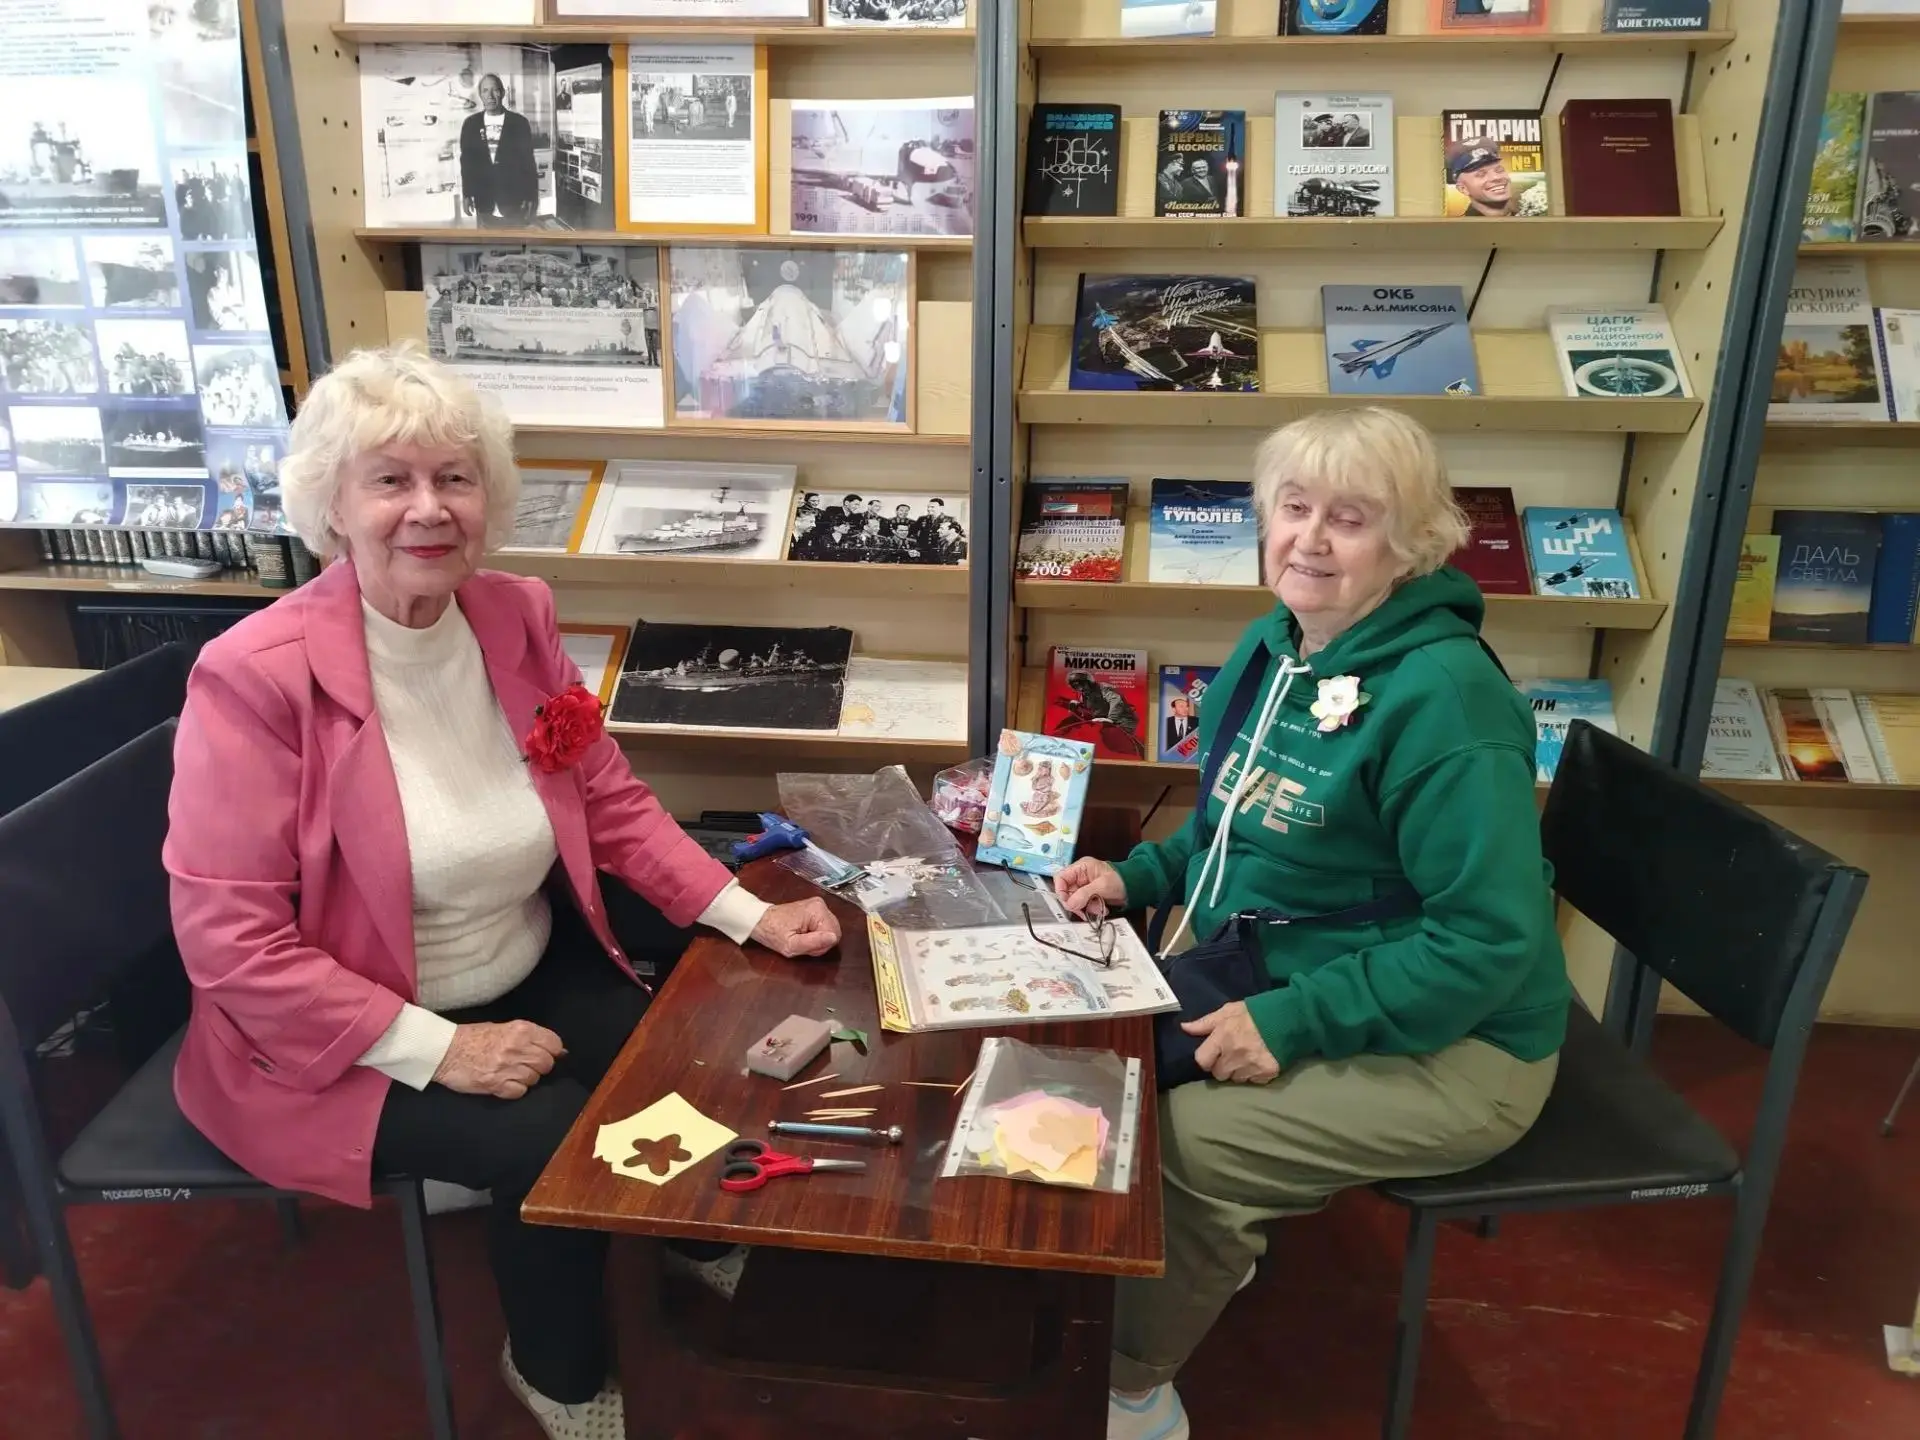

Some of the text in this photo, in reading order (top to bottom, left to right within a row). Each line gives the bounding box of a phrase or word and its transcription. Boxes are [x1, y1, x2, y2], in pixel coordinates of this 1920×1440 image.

[1617, 16, 1703, 29] КОНСТРУКТОРЫ
[1450, 119, 1541, 142] ГАГАРИН
[1169, 132, 1225, 143] ПЕРВЫЕ
[1168, 143, 1225, 152] В КОСМОСЕ
[1287, 164, 1389, 175] СДЕЛАНО В РОССИИ
[794, 212, 818, 223] 1991
[1373, 287, 1415, 301] ОКБ
[1592, 326, 1633, 334] ЦЕНТР
[1566, 332, 1664, 342] АВИАЦИОННОЙ
[1162, 510, 1244, 523] ТУПОЛЕВ
[1790, 544, 1861, 567] ДАЛЬ
[1028, 566, 1072, 576] 2005
[1787, 566, 1859, 583] СВЕТЛА
[1064, 658, 1136, 671] МИКОЯН
